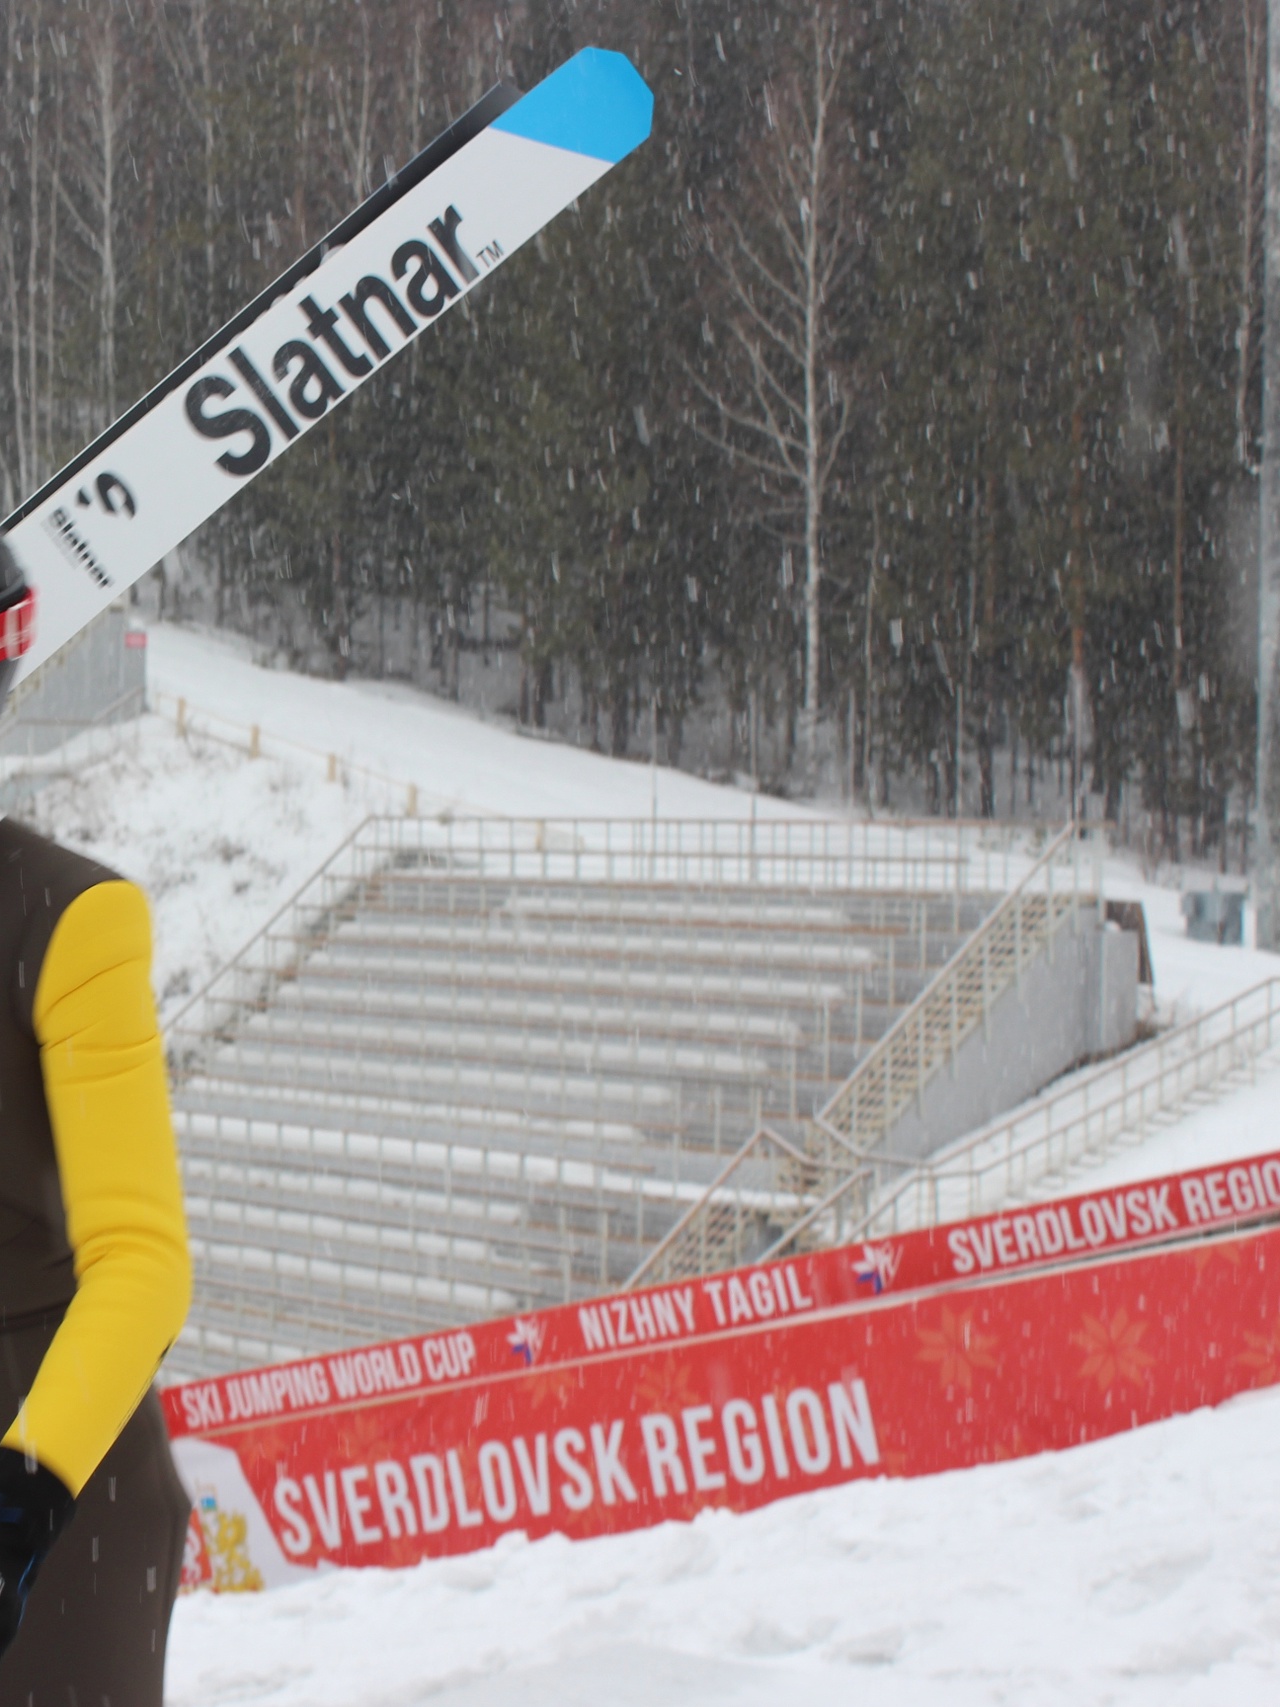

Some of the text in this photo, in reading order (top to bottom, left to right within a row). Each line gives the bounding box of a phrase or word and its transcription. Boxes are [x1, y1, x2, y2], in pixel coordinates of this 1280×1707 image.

[184, 203, 480, 476] Slatnar
[946, 1160, 1280, 1273] SVERDLOVSK REGIO
[577, 1264, 812, 1351] NIZHNY TAGIL
[180, 1332, 477, 1428] SKI JUMPING WORLD CUP
[273, 1379, 882, 1556] SVERDLOVSK REGION
